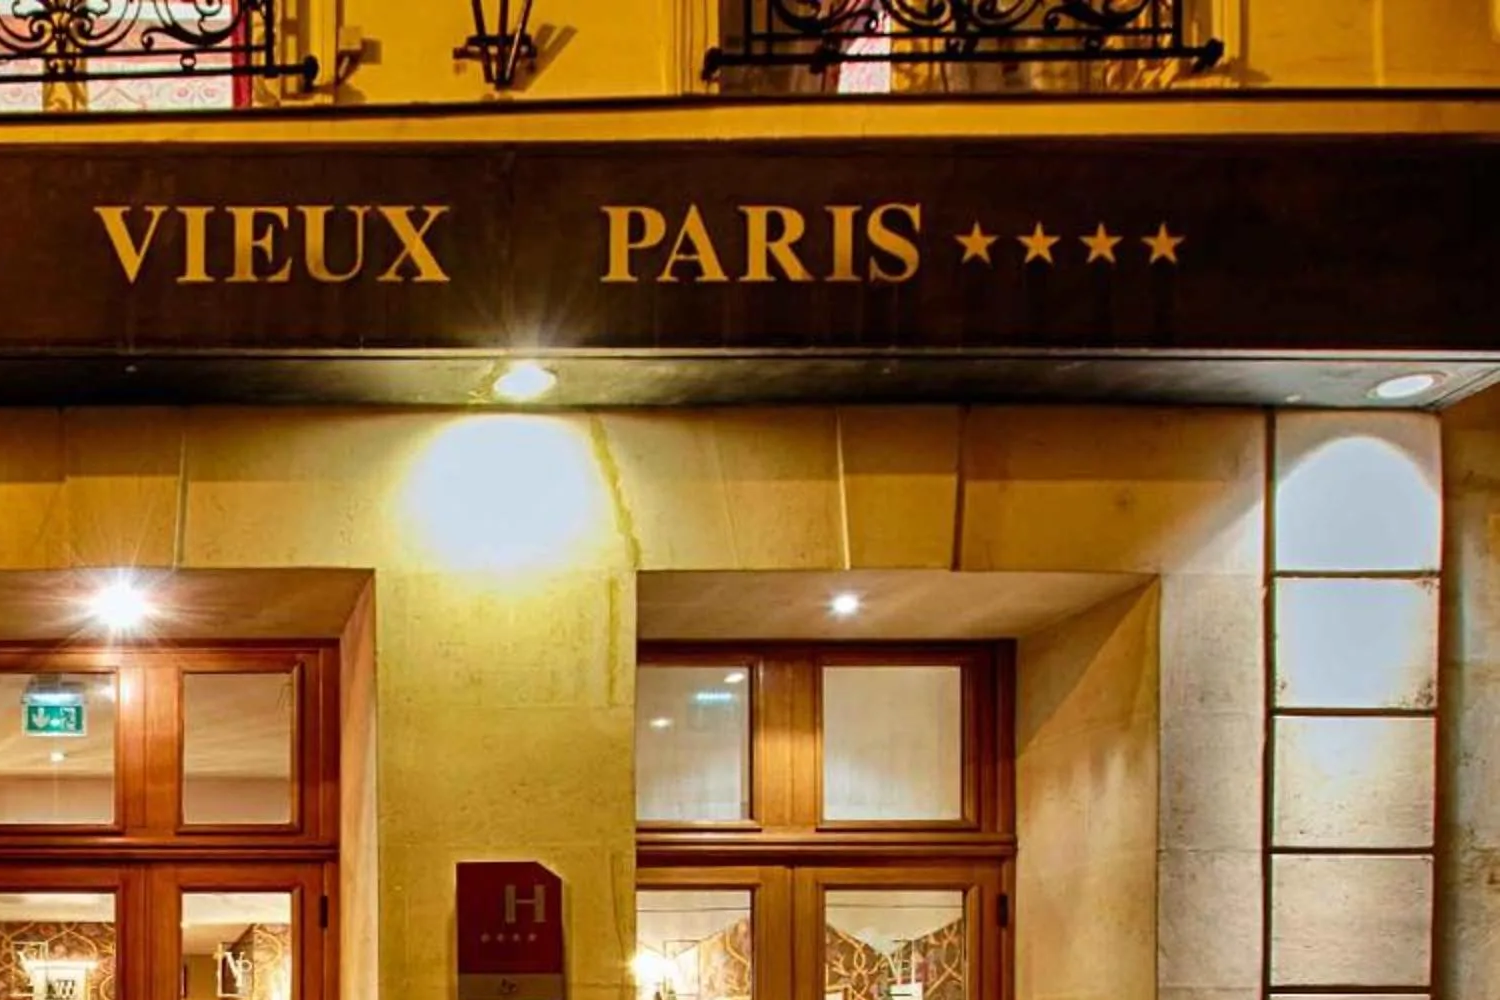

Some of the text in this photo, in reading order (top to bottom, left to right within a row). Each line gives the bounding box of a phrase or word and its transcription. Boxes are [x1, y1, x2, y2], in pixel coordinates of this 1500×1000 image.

[93, 204, 451, 286] VIEUX
[599, 201, 923, 284] PARIS
[504, 884, 547, 925] H
